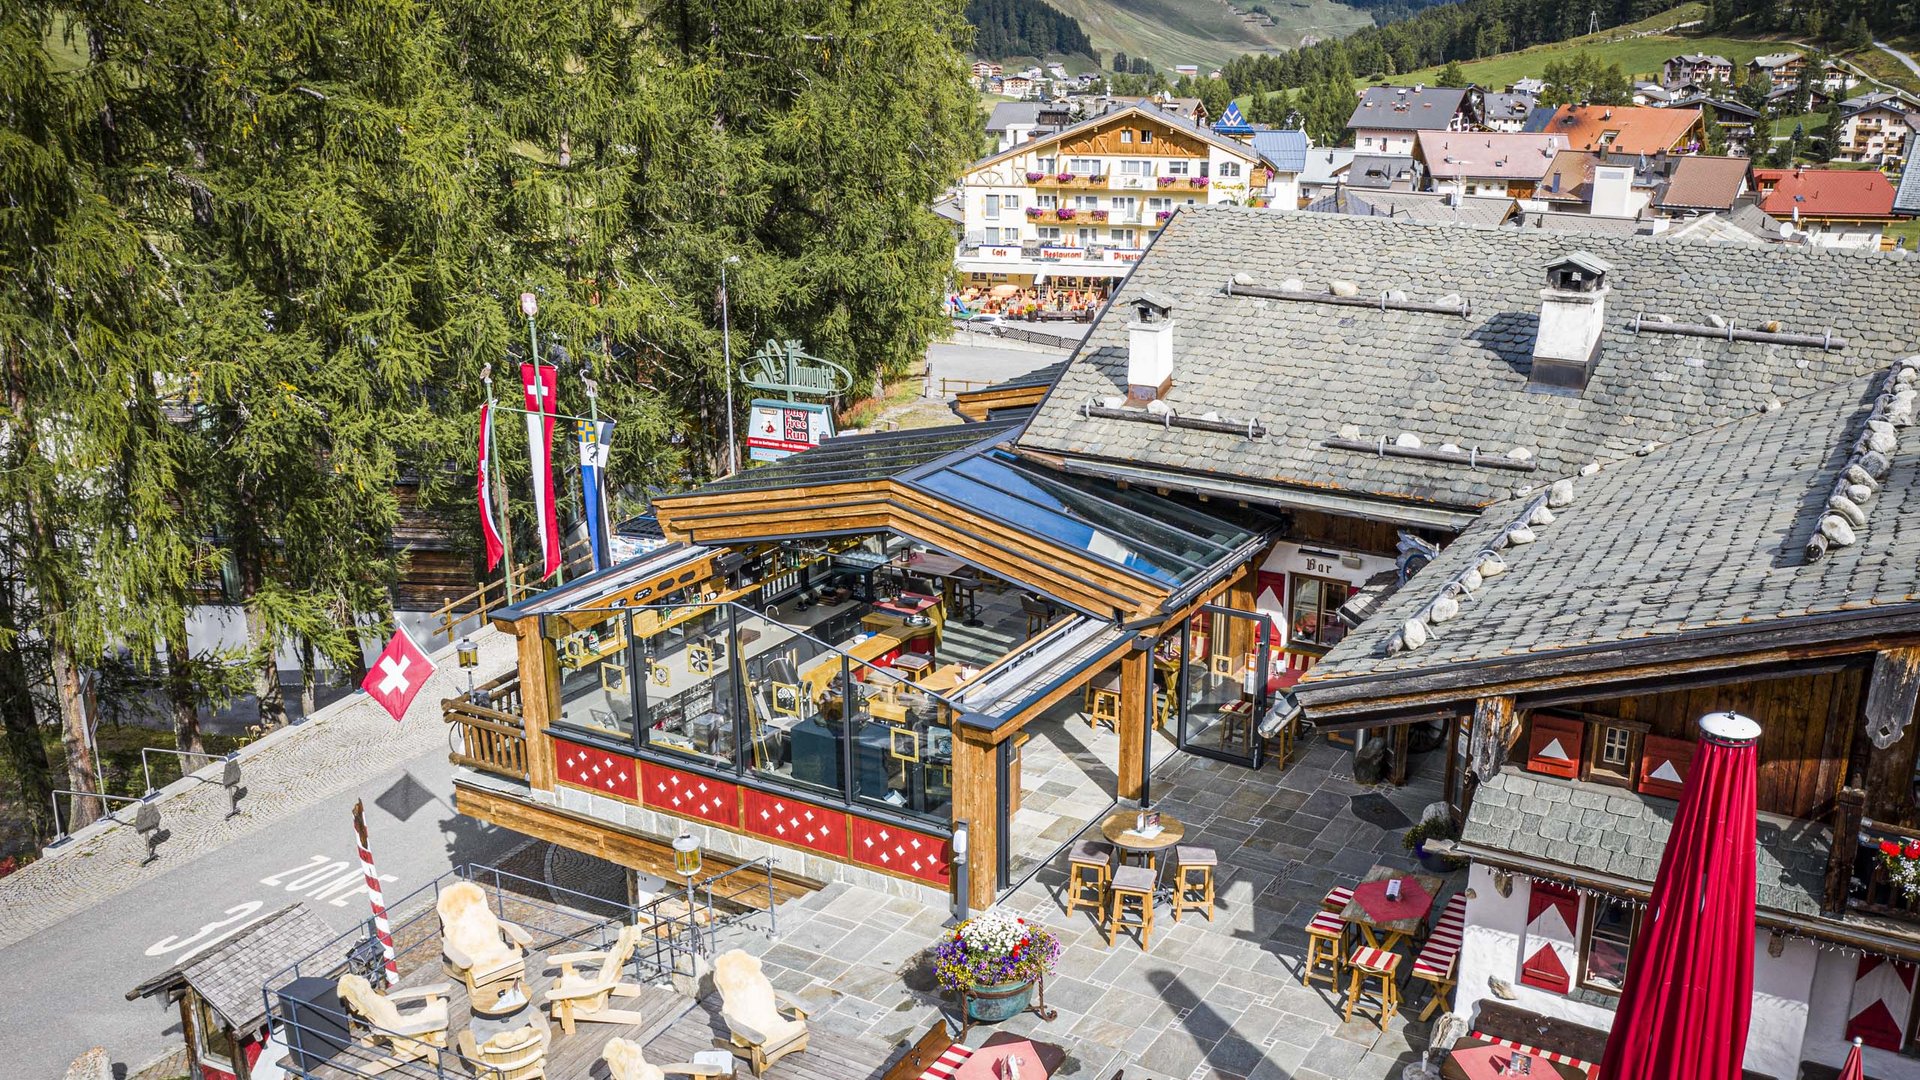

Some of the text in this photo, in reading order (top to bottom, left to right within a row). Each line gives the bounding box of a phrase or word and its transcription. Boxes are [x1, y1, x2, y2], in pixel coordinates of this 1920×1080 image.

[1043, 250, 1082, 259] Restaurant
[785, 415, 807, 429] Free
[785, 428, 807, 441] Run
[1306, 558, 1332, 574] Bar
[260, 855, 398, 907] ZONE
